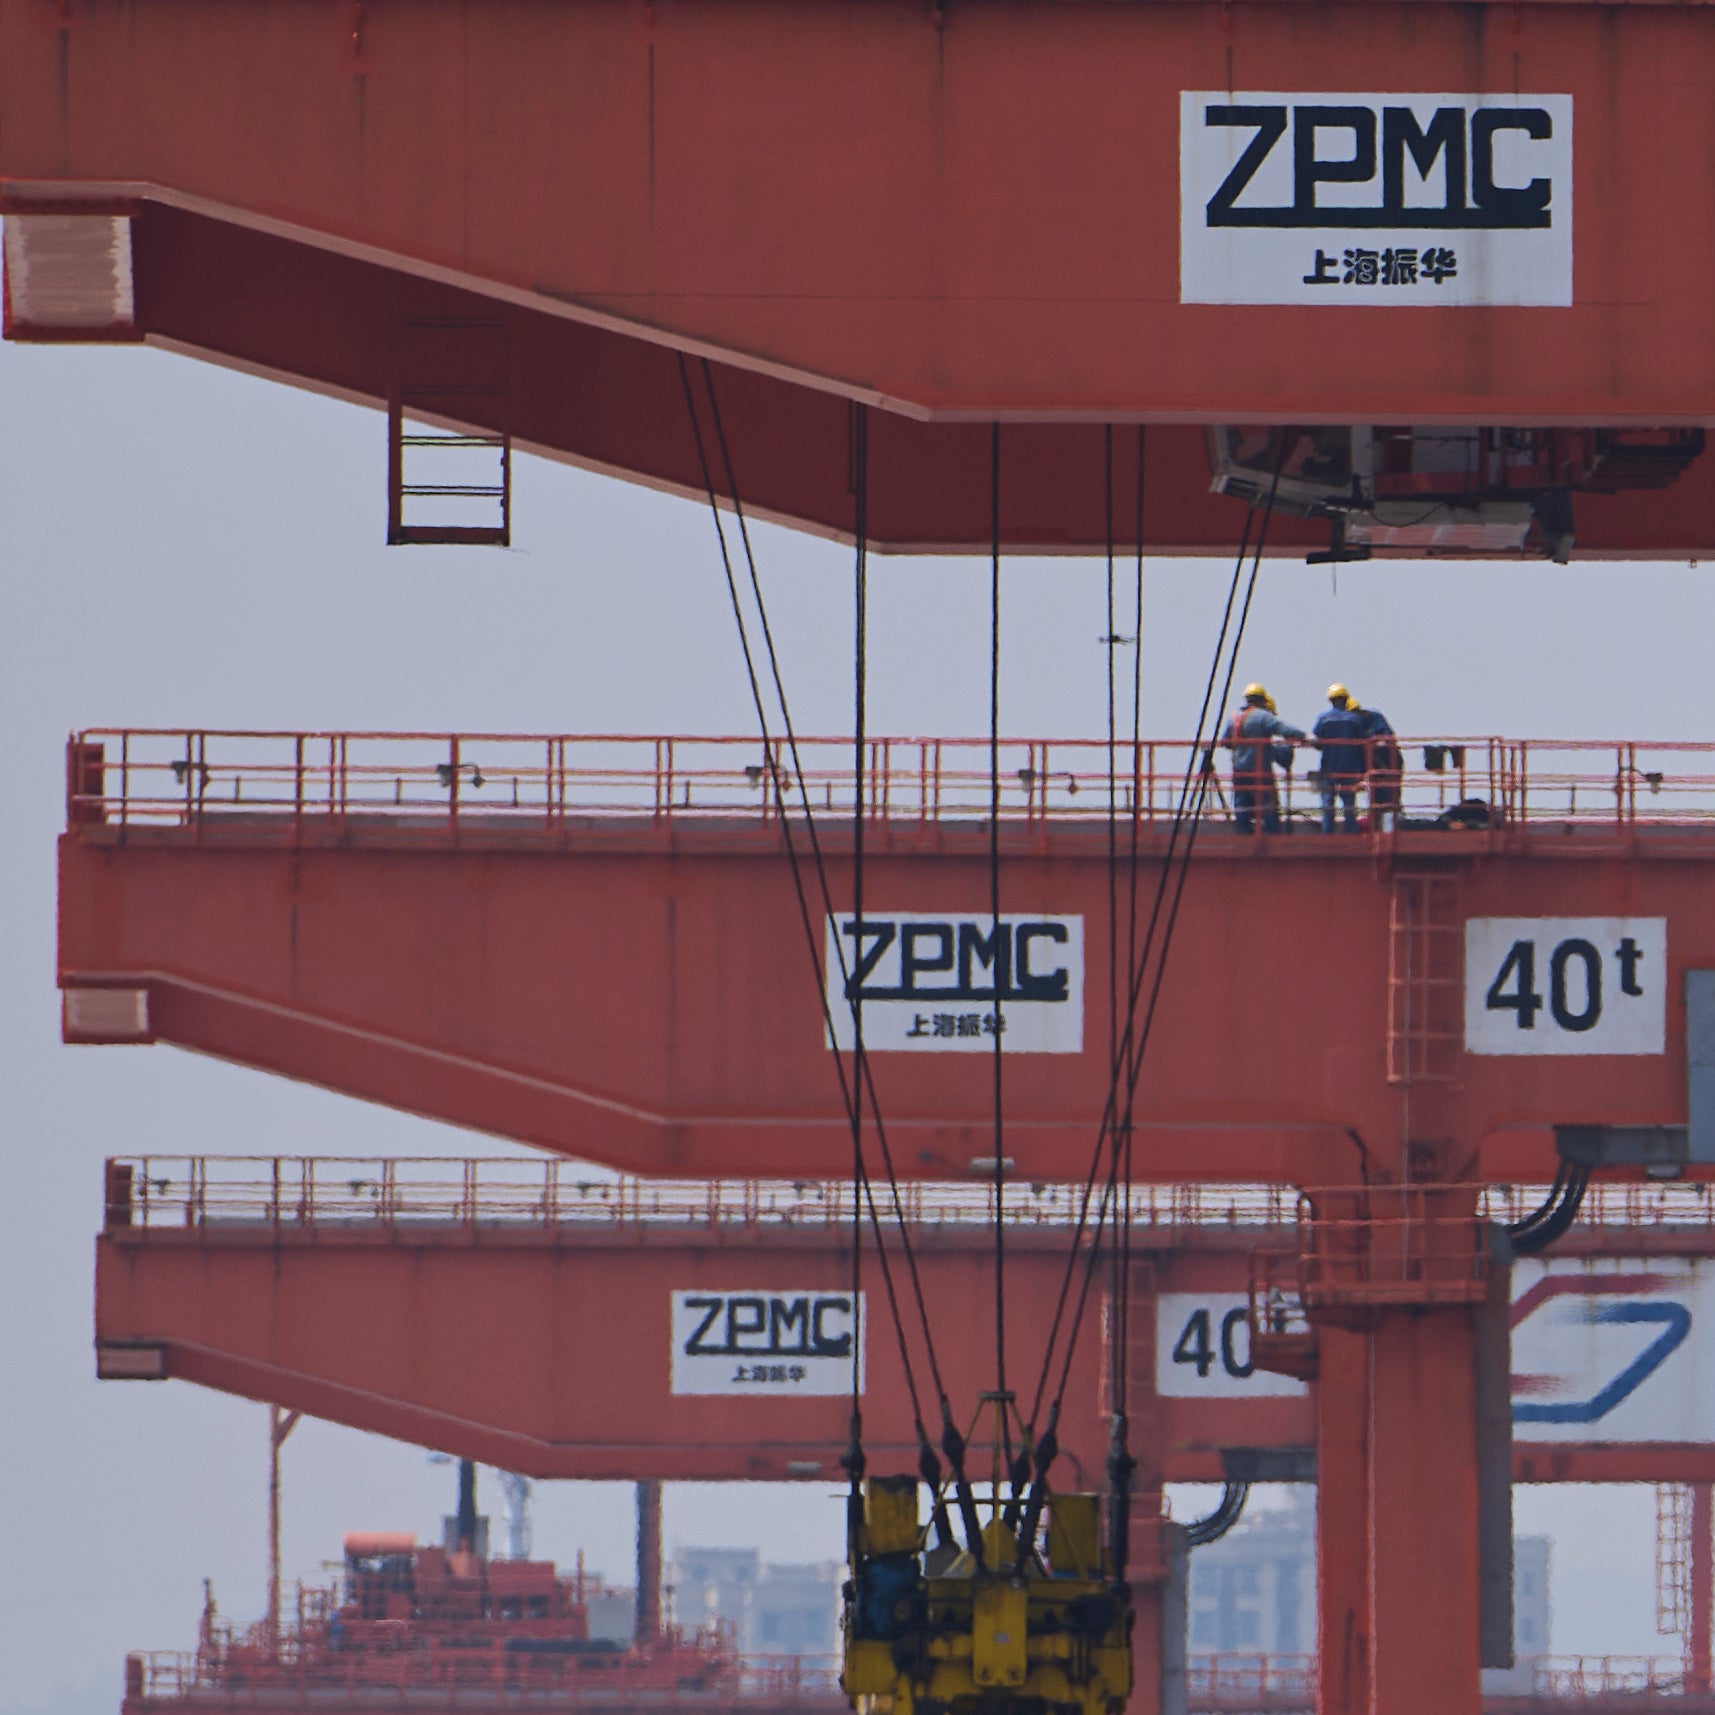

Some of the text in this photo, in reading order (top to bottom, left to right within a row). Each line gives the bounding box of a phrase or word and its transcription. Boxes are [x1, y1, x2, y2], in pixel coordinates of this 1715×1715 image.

[1206, 105, 1552, 229] ZPMC
[1303, 248, 1459, 287] 上海振华
[842, 921, 1068, 1001] ZPMC
[906, 1013, 1008, 1038] 上海振华
[685, 1298, 851, 1357] ZPMC
